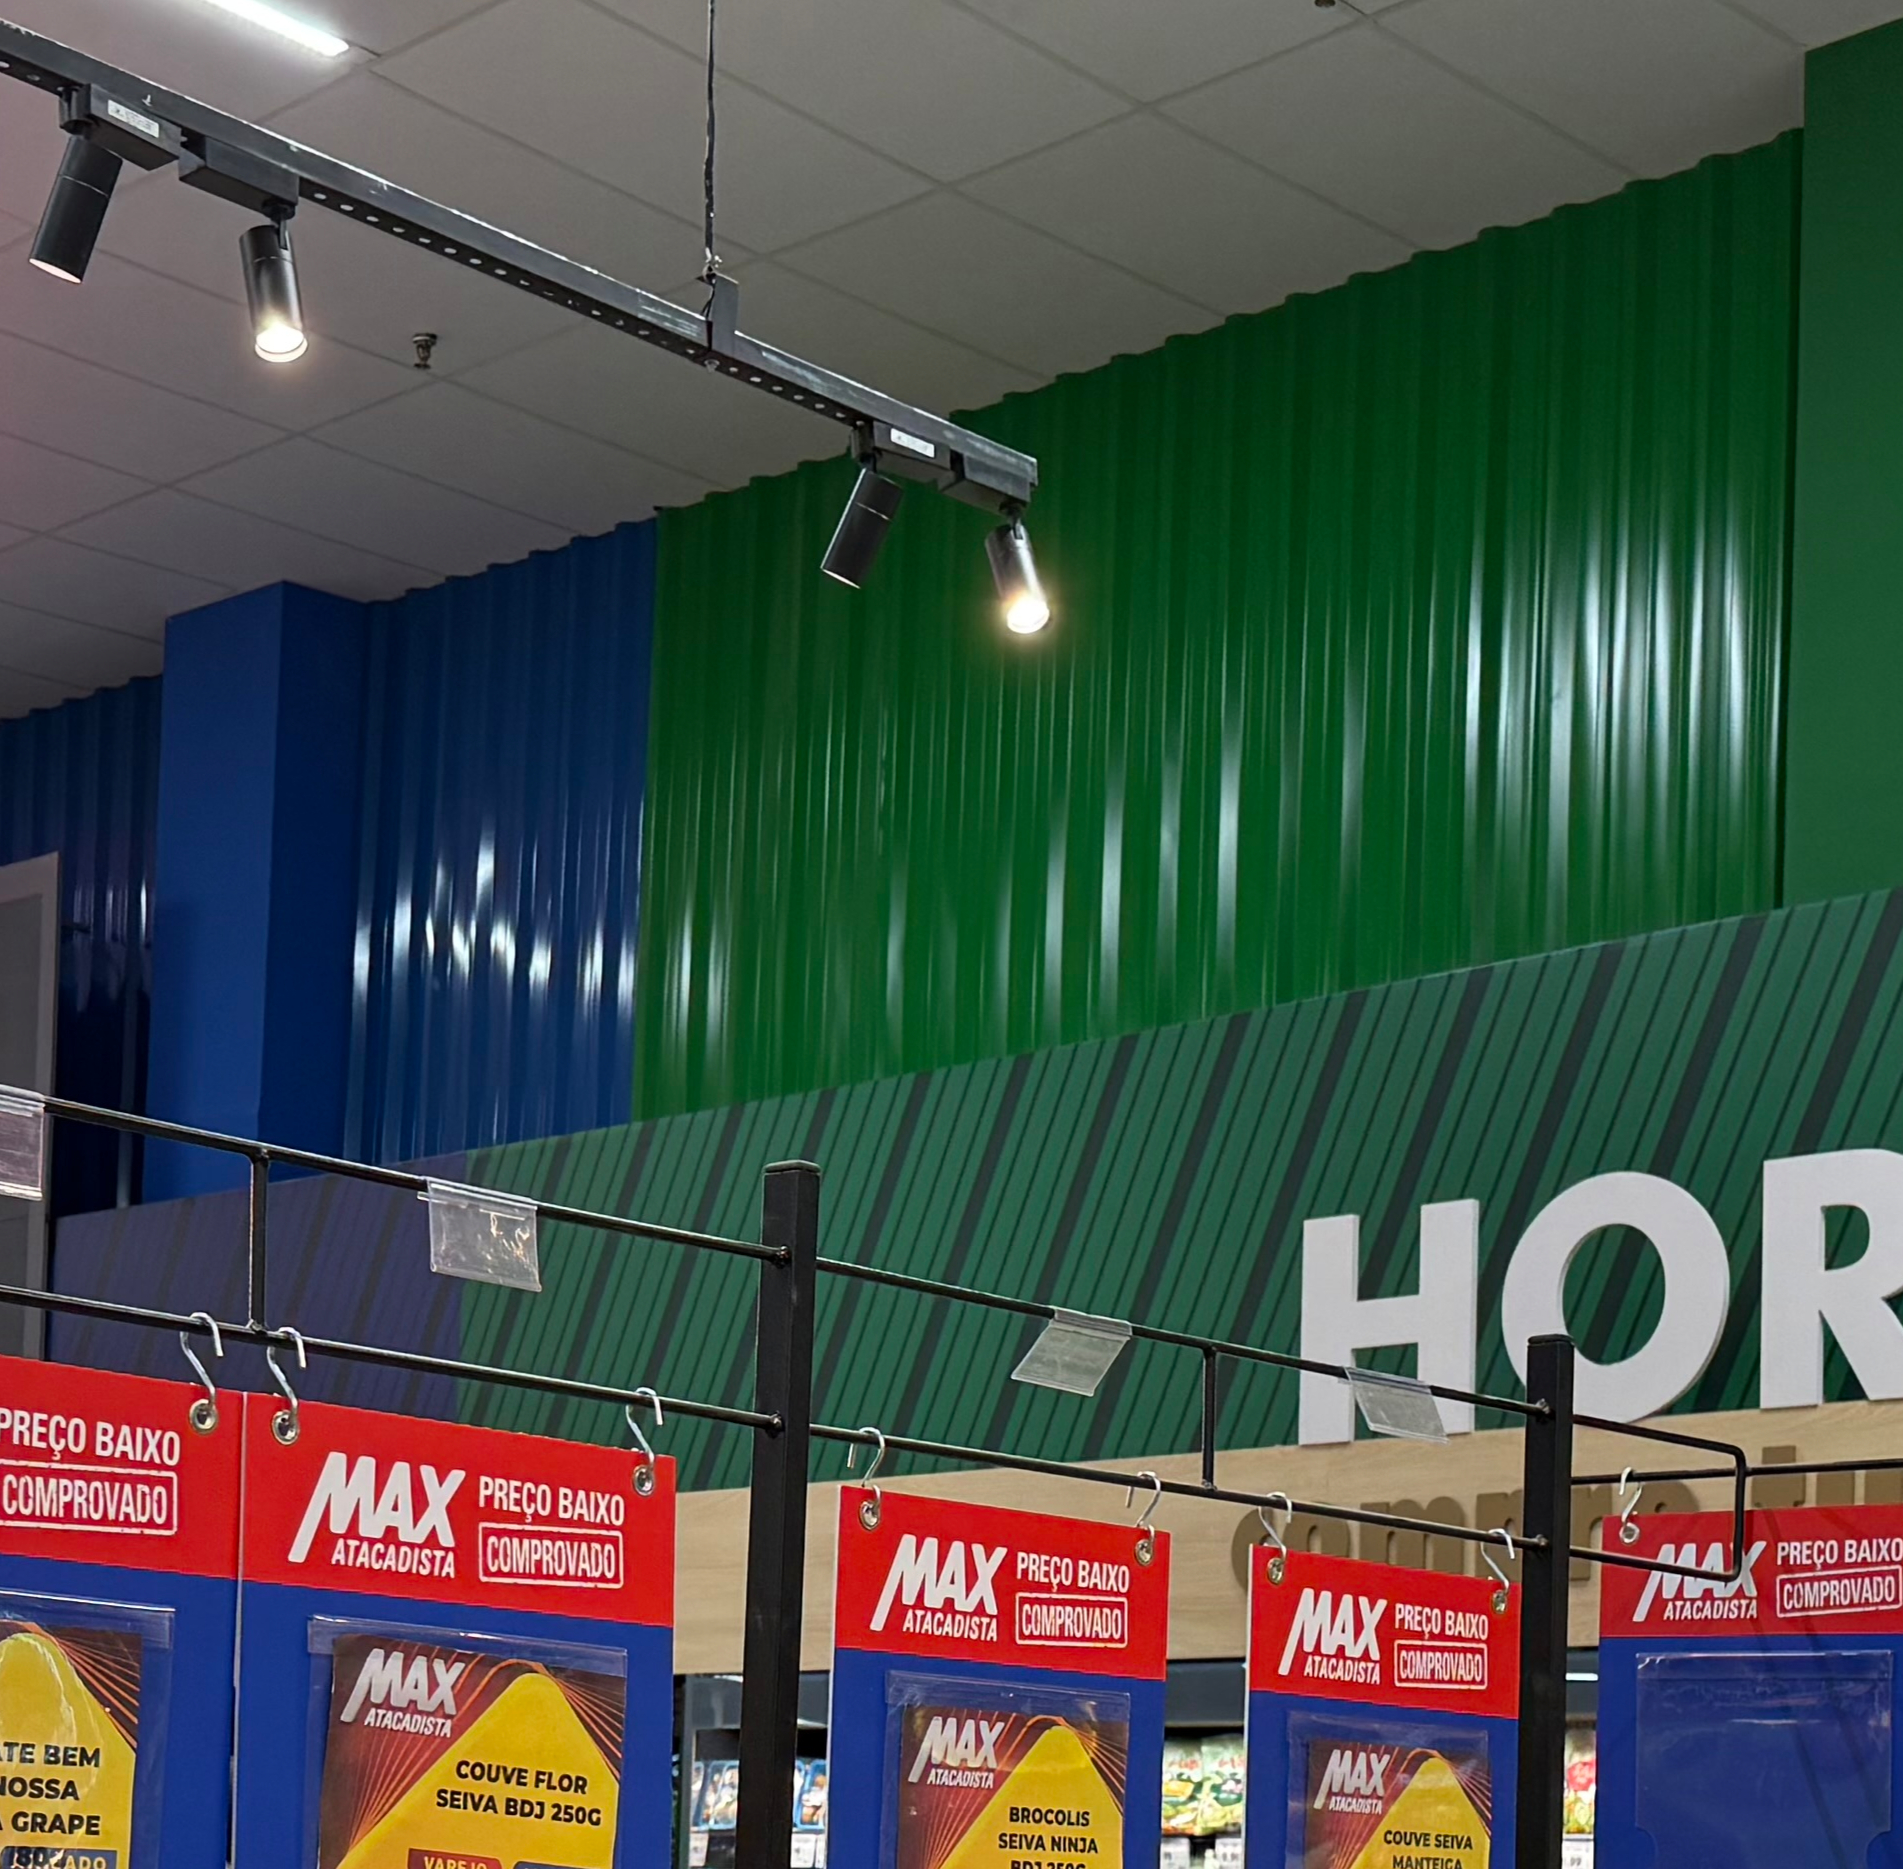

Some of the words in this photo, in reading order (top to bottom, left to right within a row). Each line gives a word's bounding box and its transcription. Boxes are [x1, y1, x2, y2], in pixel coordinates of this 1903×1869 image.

[96, 1421, 181, 1466] BAIXO
[2, 1474, 168, 1525] COMPROVADO
[288, 1451, 466, 1563] MAX
[479, 1476, 552, 1522] PREÇO
[558, 1487, 625, 1527] BAIXO
[331, 1538, 455, 1579] ATACADISTA
[486, 1535, 616, 1579] COMPROVADO
[1016, 1551, 1072, 1591] PREÇO
[1077, 1561, 1130, 1594] BAIXO
[1776, 1539, 1839, 1571] PREÇO
[869, 1534, 1008, 1632] MAX
[1632, 1541, 1767, 1622] MAX
[1782, 1576, 1895, 1611] COMPROVADO
[903, 1608, 998, 1643] ATACADISTA
[1022, 1603, 1123, 1640] COMPROVADO
[1394, 1602, 1441, 1639] PREÇO
[1445, 1609, 1489, 1642] BAIXO
[1663, 1599, 1758, 1622] ATACADISTA
[1278, 1587, 1388, 1676] MAX
[1303, 1657, 1381, 1686] ATACADISTA
[1399, 1649, 1483, 1683] COMPROVADO
[340, 1648, 466, 1722] MAX
[364, 1708, 452, 1738] ATACADISTA
[43, 1744, 101, 1768] BEM
[908, 1715, 1004, 1784] MAX
[455, 1760, 529, 1787] COUVE
[534, 1770, 588, 1794] FLOR
[927, 1768, 994, 1790] ATACADISTA
[1313, 1749, 1391, 1810] MAX
[11, 1810, 101, 1836] GRAPE
[436, 1788, 498, 1814] SEIVA
[504, 1798, 545, 1820] BDJ
[551, 1803, 602, 1826] 250G
[1009, 1806, 1091, 1828] BROCOLIS
[1329, 1795, 1383, 1815] ATACADISTA
[998, 1833, 1047, 1852] SEIVA
[1051, 1835, 1098, 1855] NINJA
[1383, 1829, 1431, 1849] COUVE
[1434, 1832, 1473, 1850] SEIVA
